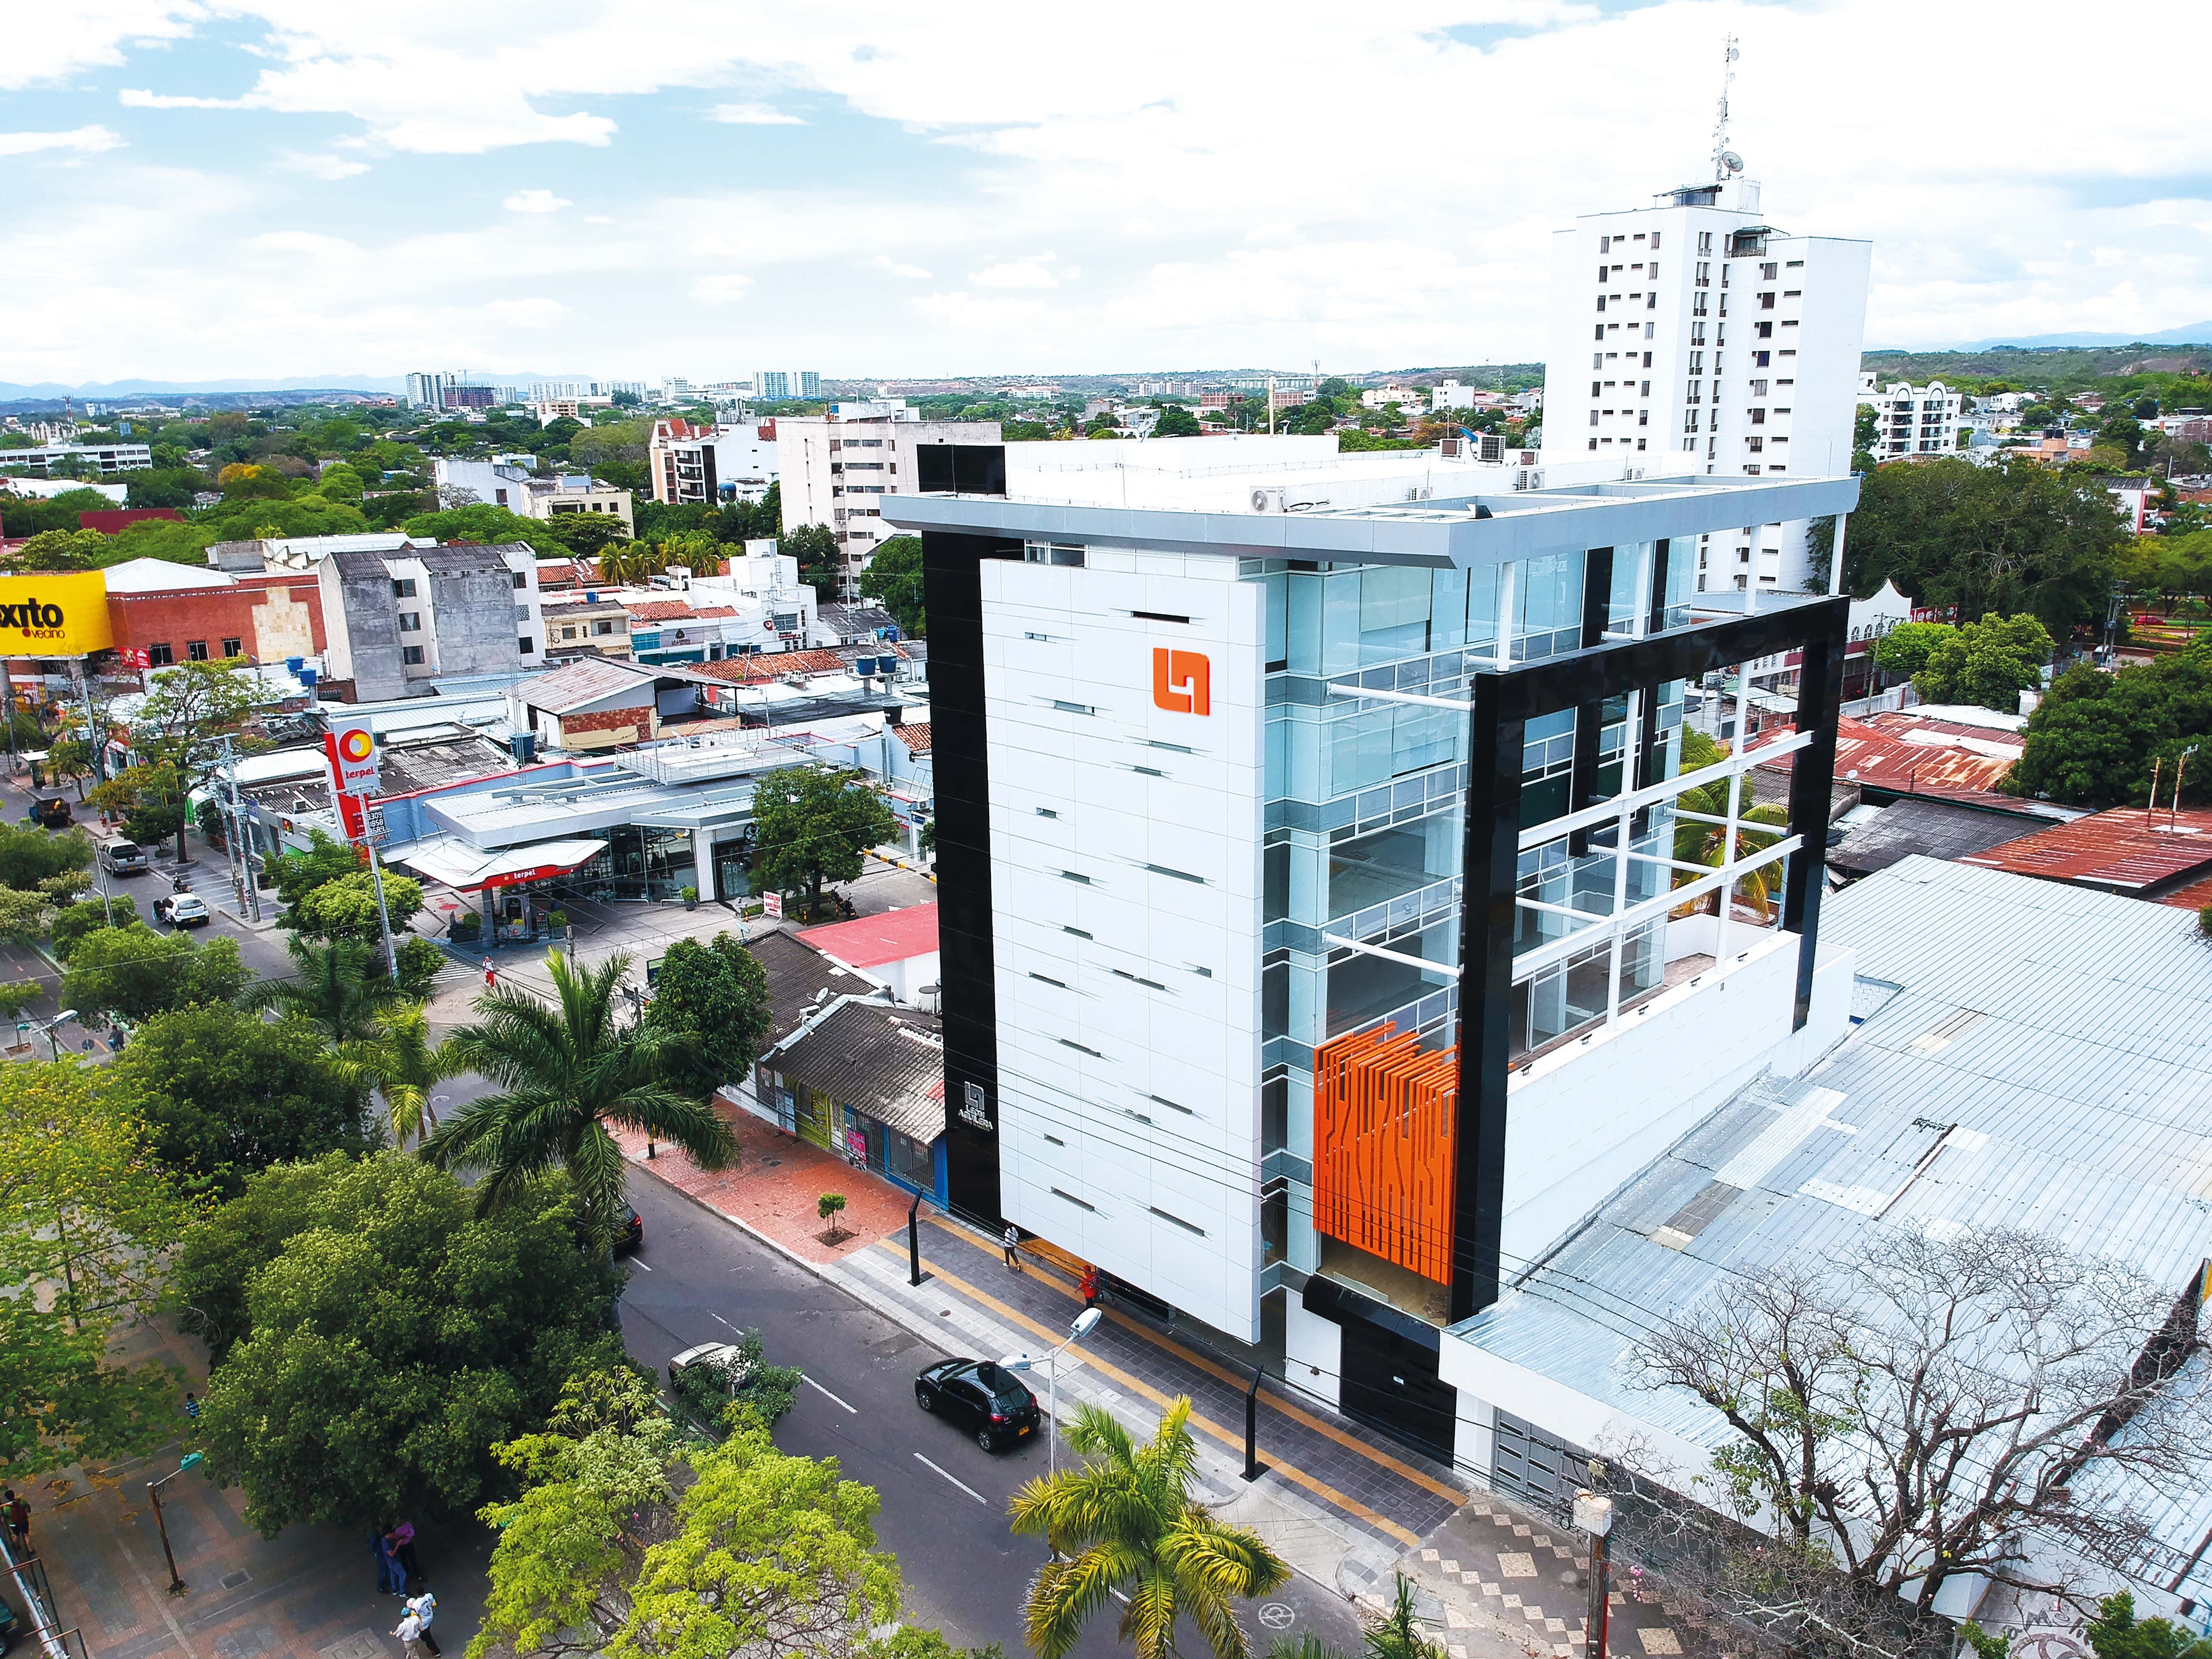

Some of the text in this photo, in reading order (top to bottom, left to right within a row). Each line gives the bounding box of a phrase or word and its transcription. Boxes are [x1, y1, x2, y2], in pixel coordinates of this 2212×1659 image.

[0, 597, 64, 628] xito
[31, 627, 65, 639] vecino
[345, 767, 375, 779] terpel
[514, 869, 536, 879] terpel
